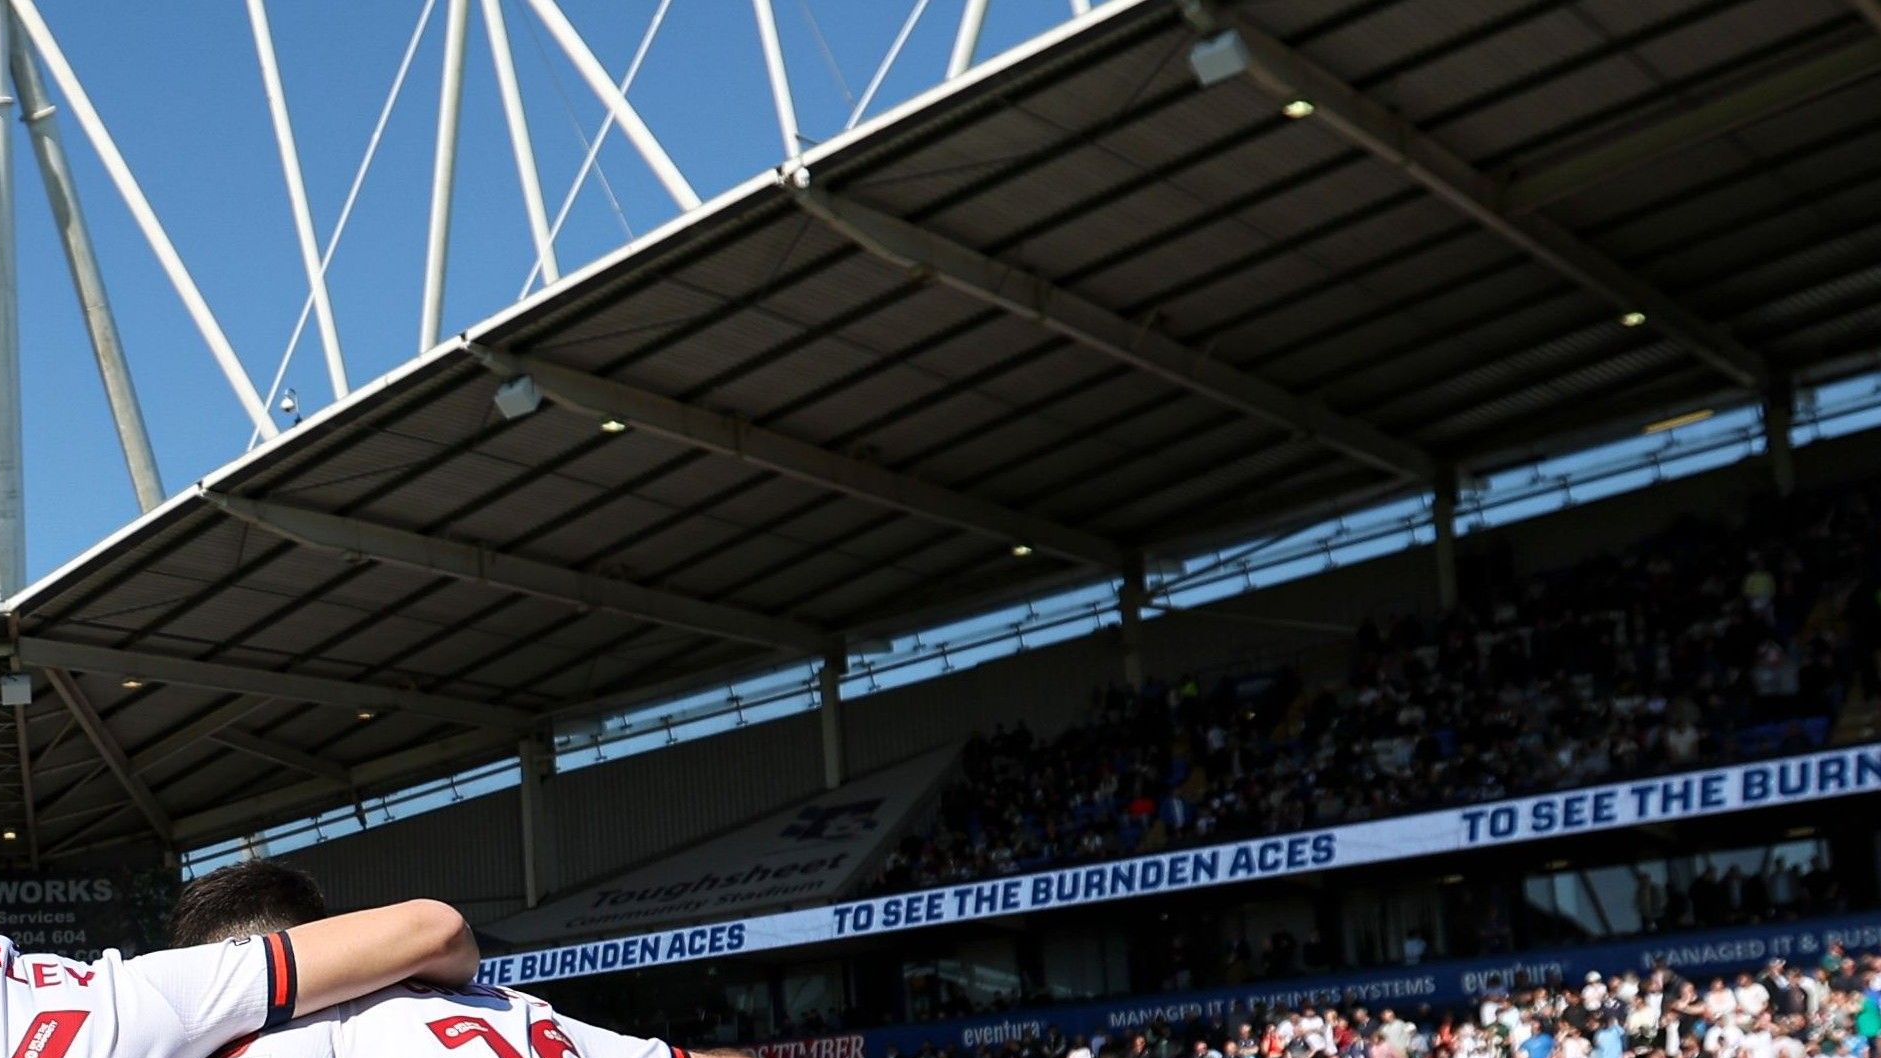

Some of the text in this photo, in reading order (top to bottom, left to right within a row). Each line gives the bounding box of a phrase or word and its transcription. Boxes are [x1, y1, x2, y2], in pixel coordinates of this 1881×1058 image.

[1462, 806, 1518, 842] TO
[1531, 790, 1619, 832] SEE
[1631, 774, 1728, 817] THE
[593, 853, 849, 908] Toughsheet
[834, 833, 1337, 934] TO SEE THE BURNDEN ACES
[52, 929, 87, 945] 604
[476, 922, 746, 985] HE BURNDEN ACES
[1771, 935, 1794, 956] IT
[1798, 932, 1819, 953] &
[963, 1019, 1041, 1048] eventura
